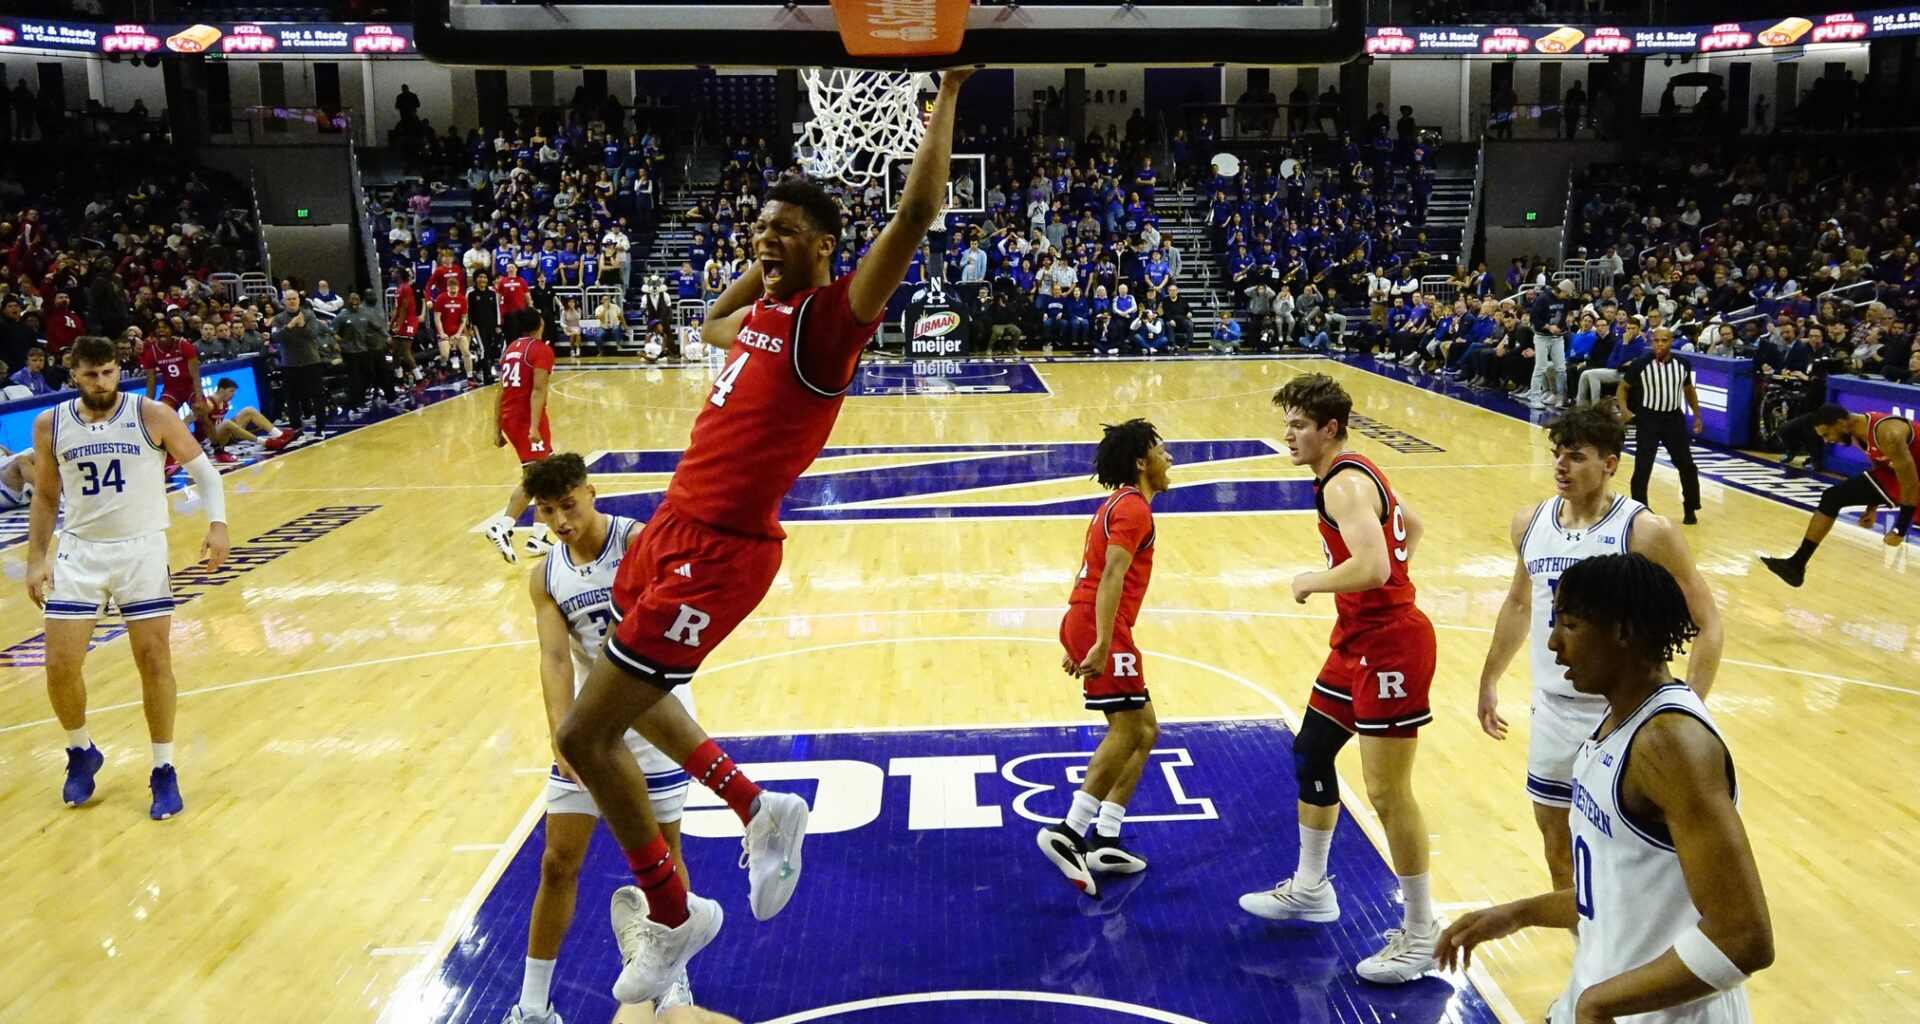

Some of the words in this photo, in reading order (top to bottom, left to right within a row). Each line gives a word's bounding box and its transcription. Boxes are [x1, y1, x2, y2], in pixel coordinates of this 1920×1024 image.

[1825, 13, 1854, 23] PIZZA
[1873, 14, 1894, 24] Hot
[1896, 13, 1906, 22] &
[22, 24, 44, 35] Hot
[47, 26, 57, 35] &
[60, 27, 96, 40] Ready
[114, 25, 145, 34] PIZZA
[234, 26, 262, 35] PIZZA
[365, 26, 393, 35] PIZZA
[1378, 27, 1403, 36] PIZZA
[1494, 28, 1518, 36] PIZZA
[1595, 27, 1620, 36] PIZZA
[1713, 24, 1740, 33] PIZZA
[1813, 23, 1867, 42] PUFF
[1873, 24, 1883, 32] at
[36, 34, 96, 45] Concessions
[103, 34, 159, 52] PUFF
[223, 34, 275, 52] PUFF
[281, 31, 300, 39] Hot
[303, 31, 312, 39] &
[315, 31, 348, 41] Ready
[282, 39, 292, 47] at
[293, 39, 347, 47] Concessions
[354, 34, 406, 52] PUFF
[1419, 32, 1437, 41] Hot
[1439, 32, 1447, 41] &
[1449, 32, 1479, 42] Ready
[1636, 32, 1654, 41] Hot
[1656, 32, 1664, 40] &
[1666, 32, 1697, 41] Ready
[1701, 32, 1752, 51] PUFF
[1367, 36, 1415, 52] PUFF
[1430, 40, 1478, 48] Concessions
[1482, 36, 1530, 52] PUFF
[1584, 36, 1632, 53] PUFF
[1647, 40, 1696, 48] Concessions
[931, 276, 941, 291] N
[913, 316, 956, 337] LIBMAN
[911, 336, 962, 356] meijer
[167, 364, 180, 378] 9
[502, 362, 521, 388] 24
[710, 351, 751, 408] 4
[62, 442, 141, 463] NORTHWESTERN
[77, 459, 126, 496] 34
[664, 603, 711, 647] R
[1113, 652, 1138, 677] R
[1377, 671, 1408, 699] R
[1574, 835, 1595, 921] 0
